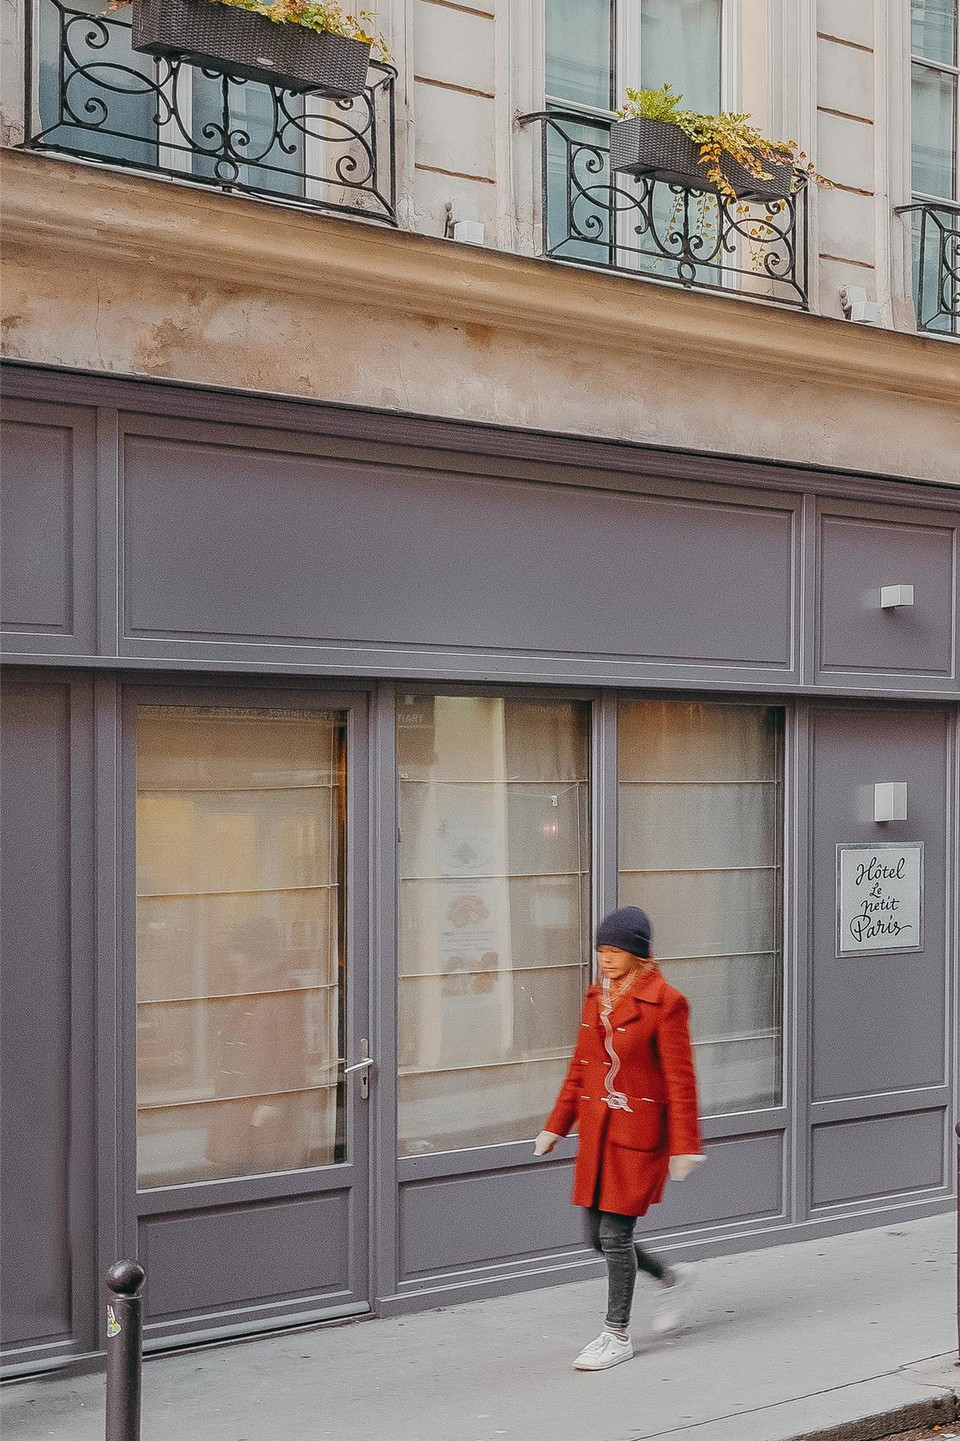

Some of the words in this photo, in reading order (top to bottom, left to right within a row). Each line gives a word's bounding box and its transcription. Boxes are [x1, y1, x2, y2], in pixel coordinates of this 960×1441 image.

[855, 857, 905, 886] Hôtel
[869, 882, 882, 898] Le
[861, 896, 900, 921] petit
[850, 914, 912, 942] Paris
